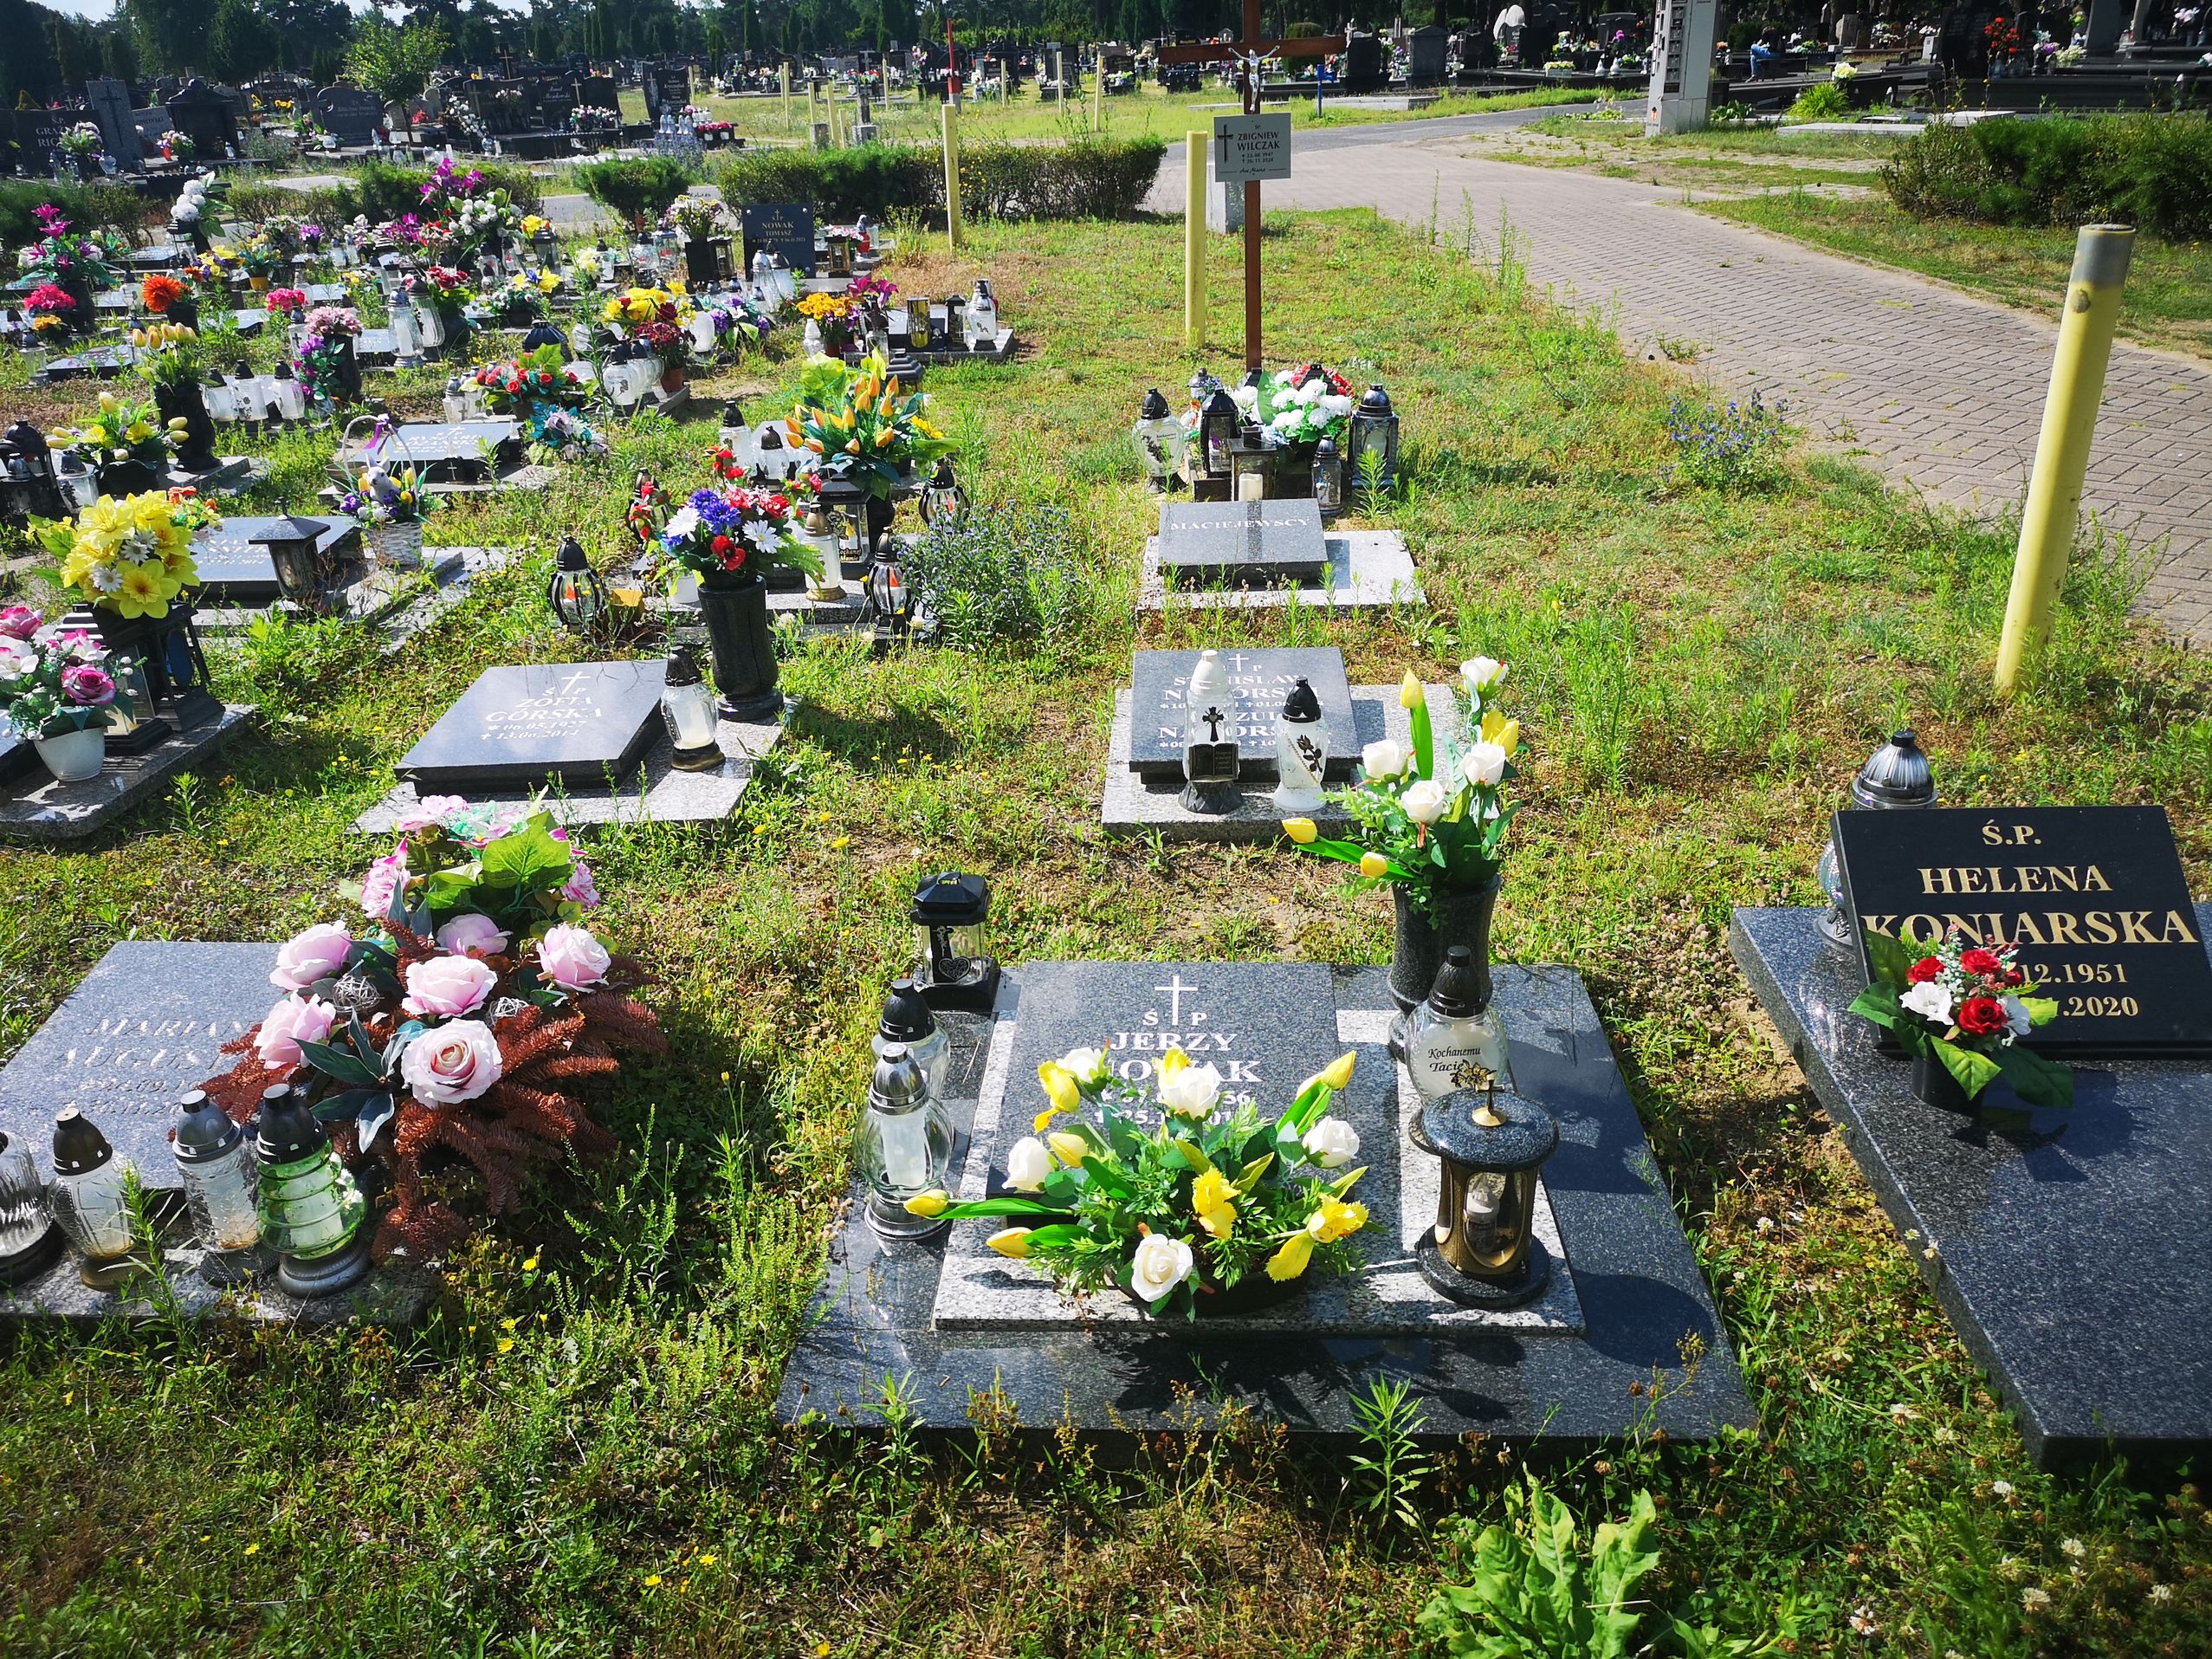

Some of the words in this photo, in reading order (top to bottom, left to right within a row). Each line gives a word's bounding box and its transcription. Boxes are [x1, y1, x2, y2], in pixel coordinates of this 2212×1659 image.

[1238, 131, 1279, 140] ZBIGNIEW
[1237, 140, 1280, 151] WILCZAK
[1171, 518, 1310, 530] MACIEJEWSCY
[514, 697, 592, 708] ZOFIA
[485, 707, 603, 723] GÓRSKA
[1982, 819, 2042, 846] Ś.P.
[1917, 865, 2113, 895] HELENA
[1860, 908, 2200, 945] KONIARSKA
[1142, 1008, 1159, 1026] Ś
[1191, 1012, 1207, 1026] P
[1109, 1032, 1238, 1051] JERZY
[1427, 1046, 1482, 1060] Kochanemu
[1429, 1061, 1464, 1073] Tacie
